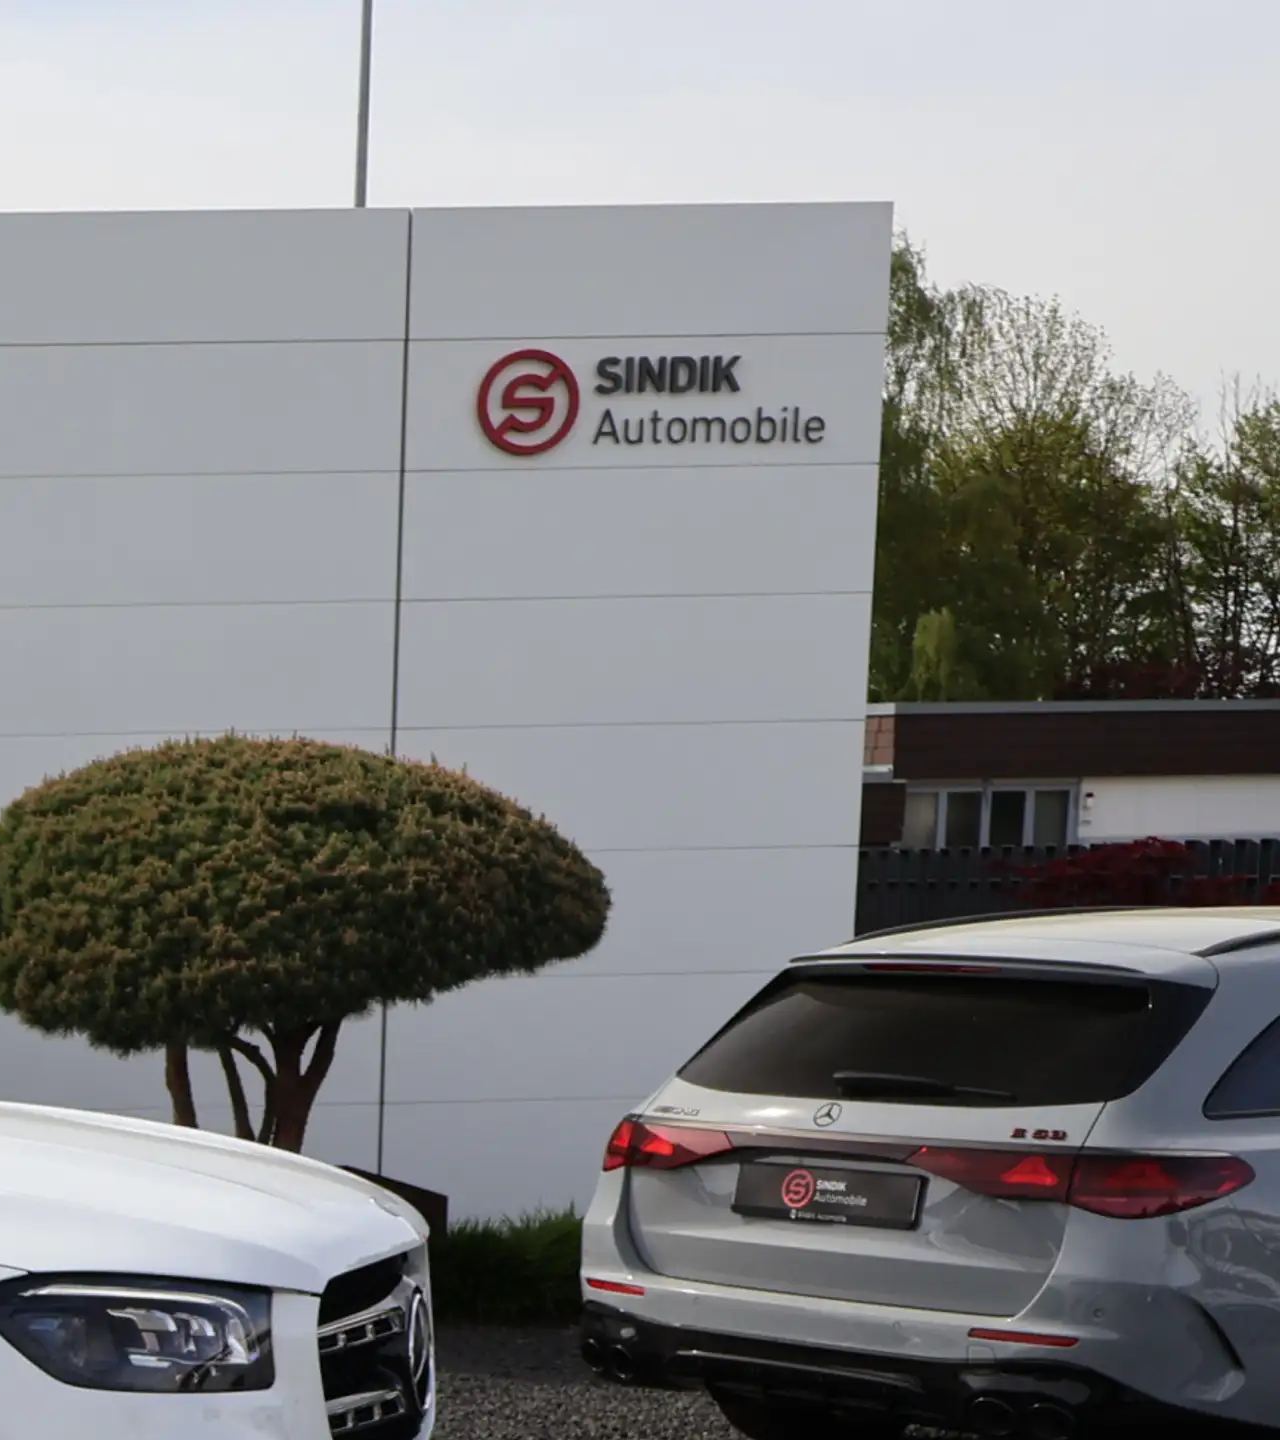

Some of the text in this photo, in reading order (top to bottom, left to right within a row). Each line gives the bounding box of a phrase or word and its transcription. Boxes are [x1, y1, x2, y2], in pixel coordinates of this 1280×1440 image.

[594, 355, 742, 394] SINDIK
[592, 406, 826, 445] Automobile
[813, 1191, 867, 1206] Automobile
[816, 1180, 847, 1191] SINDIK
